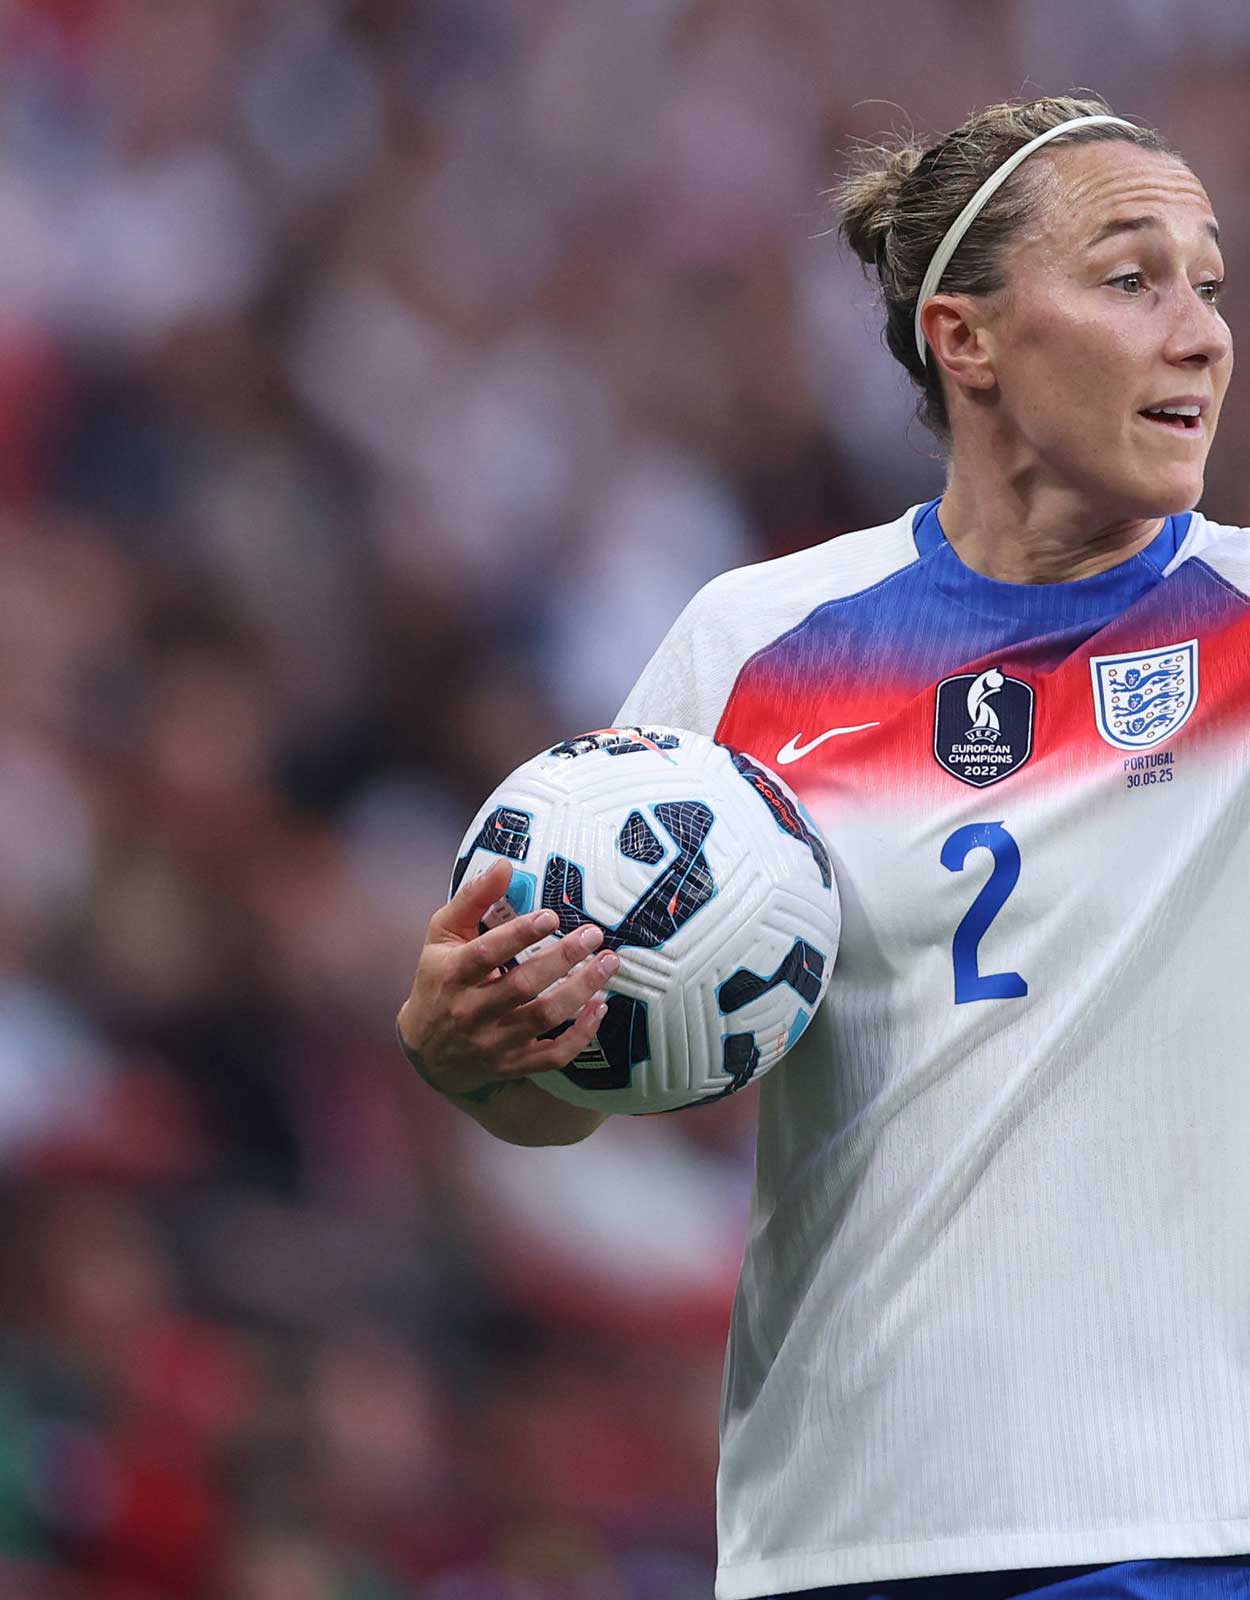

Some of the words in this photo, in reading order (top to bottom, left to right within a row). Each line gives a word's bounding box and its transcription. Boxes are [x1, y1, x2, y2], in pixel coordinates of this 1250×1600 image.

[966, 730, 998, 741] UEFA
[951, 744, 1011, 754] EUROPEAN
[948, 754, 1013, 764] CHAMPIONS
[1124, 751, 1175, 771] PORTUGAL
[964, 765, 998, 776] 2022
[1127, 768, 1173, 788] 30.05.25
[940, 821, 1028, 1005] 2
